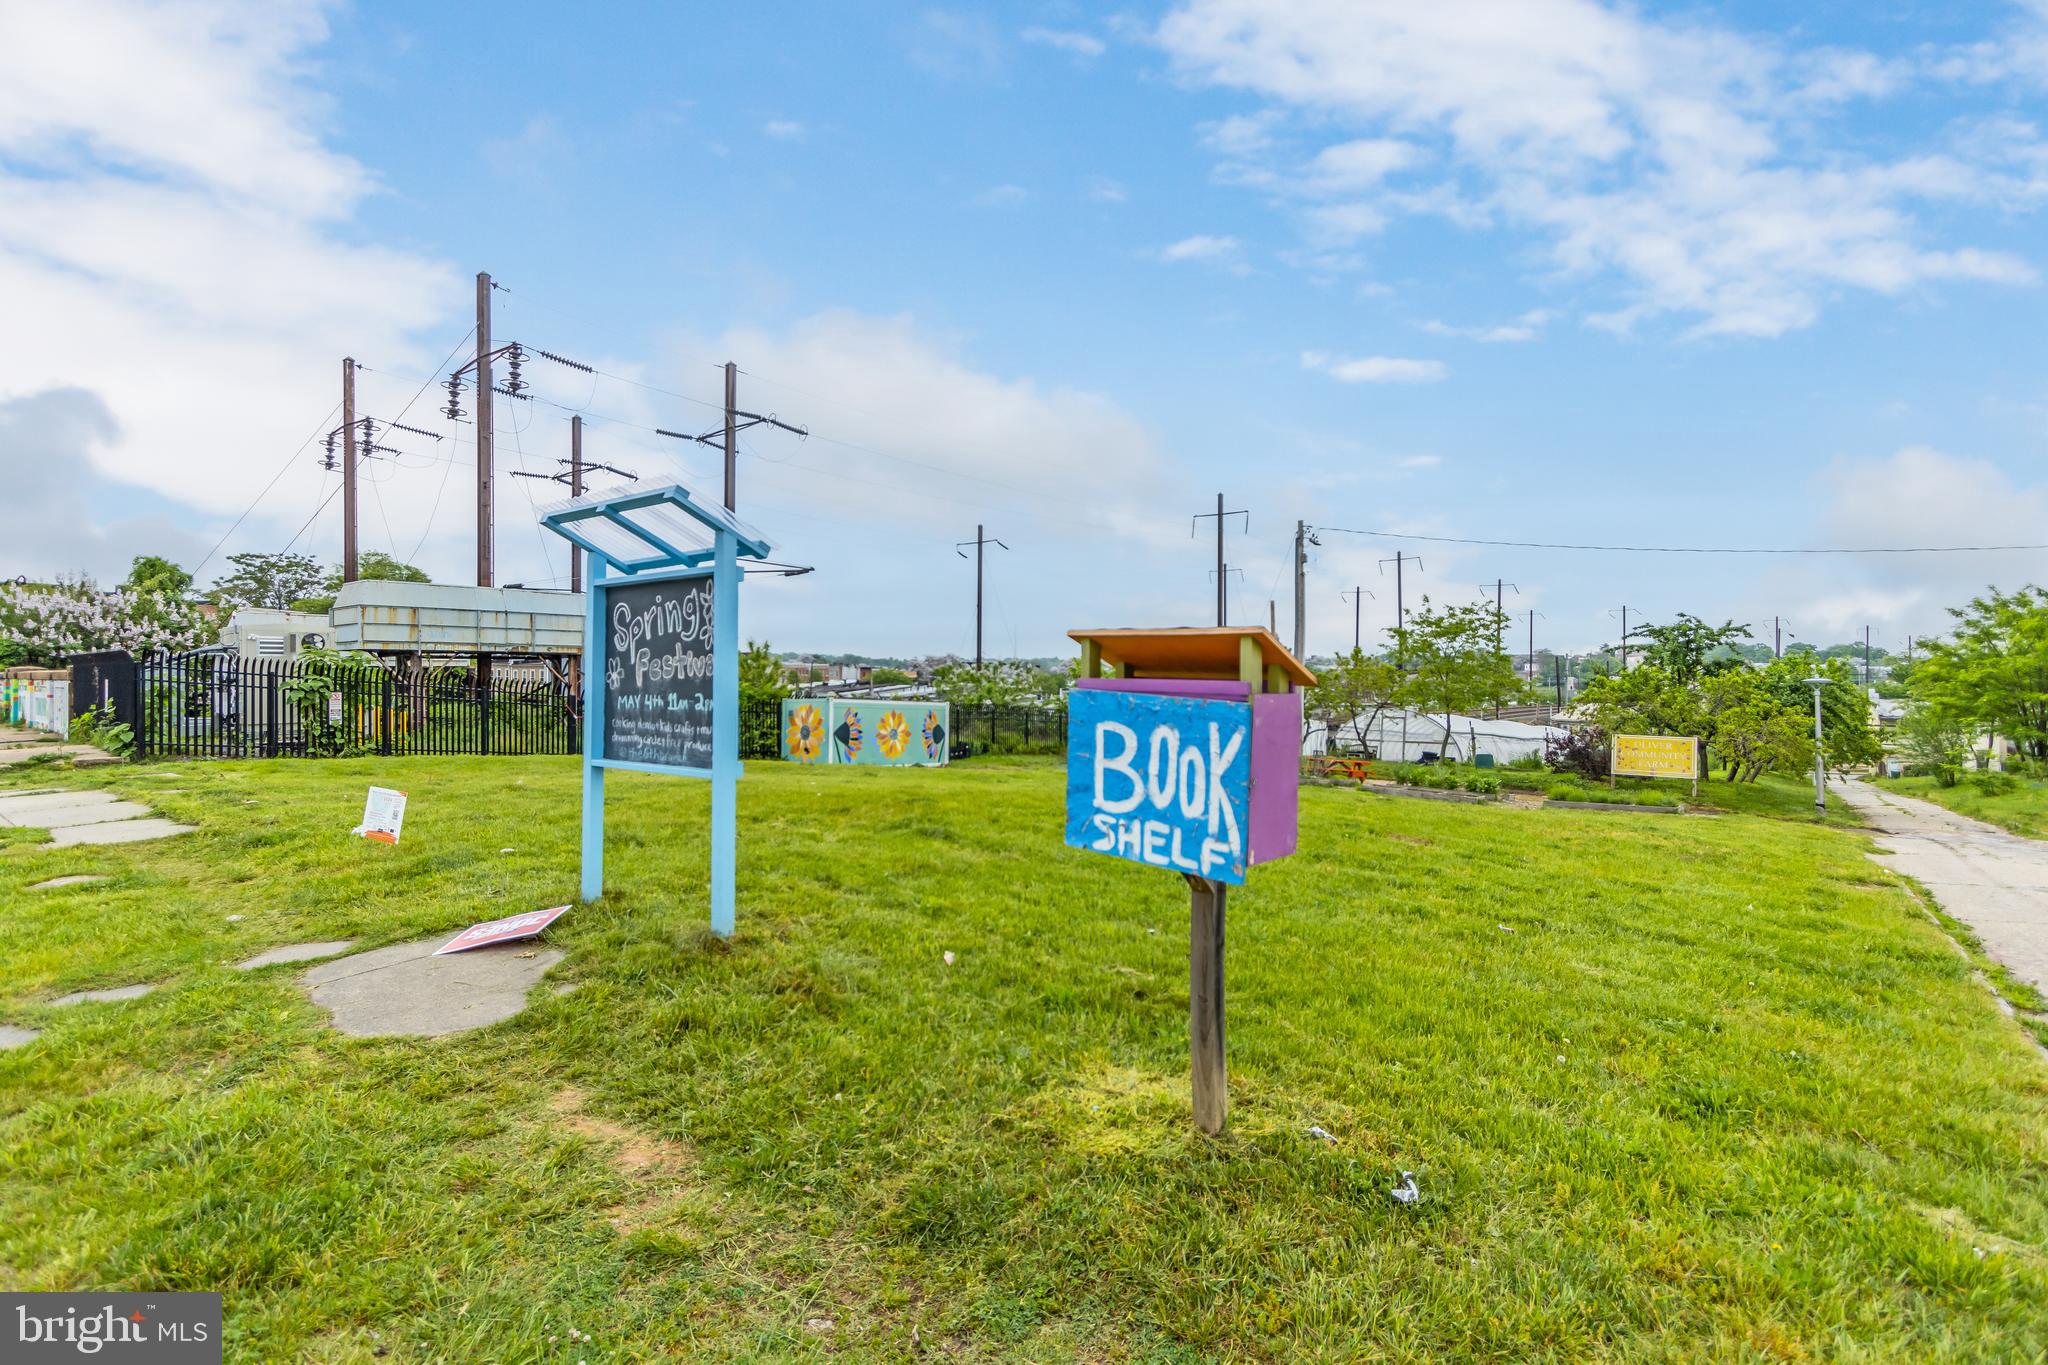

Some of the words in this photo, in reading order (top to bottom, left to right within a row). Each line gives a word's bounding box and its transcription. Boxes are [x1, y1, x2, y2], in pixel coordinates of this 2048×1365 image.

[612, 587, 701, 665] Spring
[635, 642, 714, 688] Festiva
[617, 694, 641, 710] MAY
[644, 693, 664, 710] 4th
[1092, 720, 1247, 858] BOOK
[1091, 813, 1231, 876] SHELF
